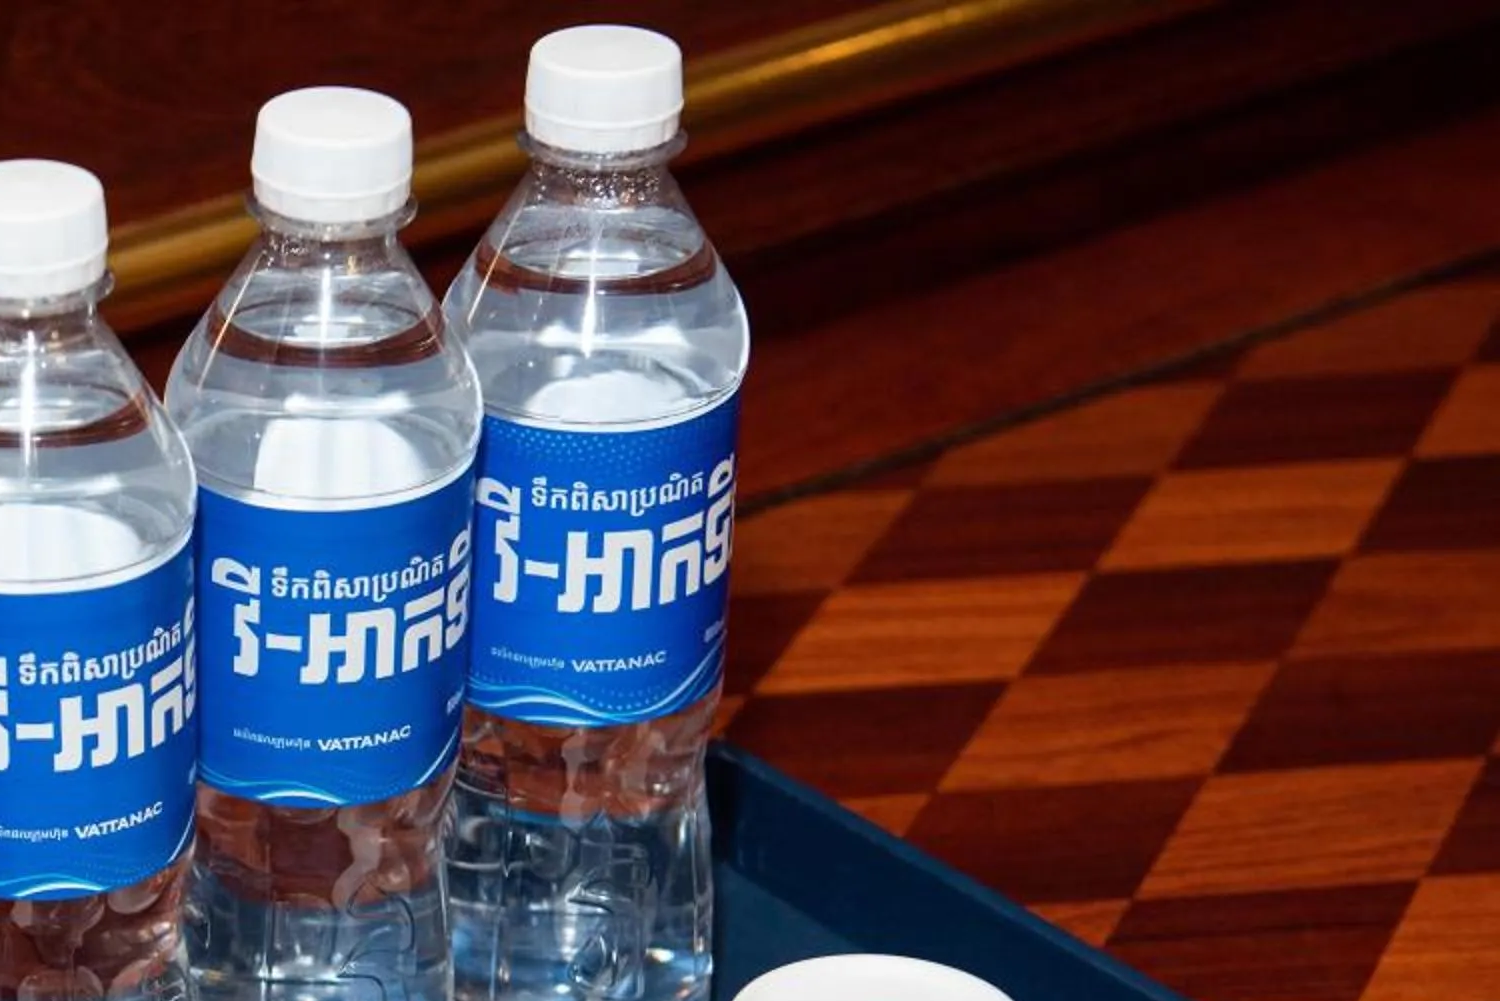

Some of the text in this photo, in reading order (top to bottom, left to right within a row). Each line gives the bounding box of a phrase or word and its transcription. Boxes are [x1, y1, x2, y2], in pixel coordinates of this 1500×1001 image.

[571, 649, 668, 673] VATTANAC
[317, 724, 411, 752] VATTANAC
[74, 801, 164, 840] VATTANAC
